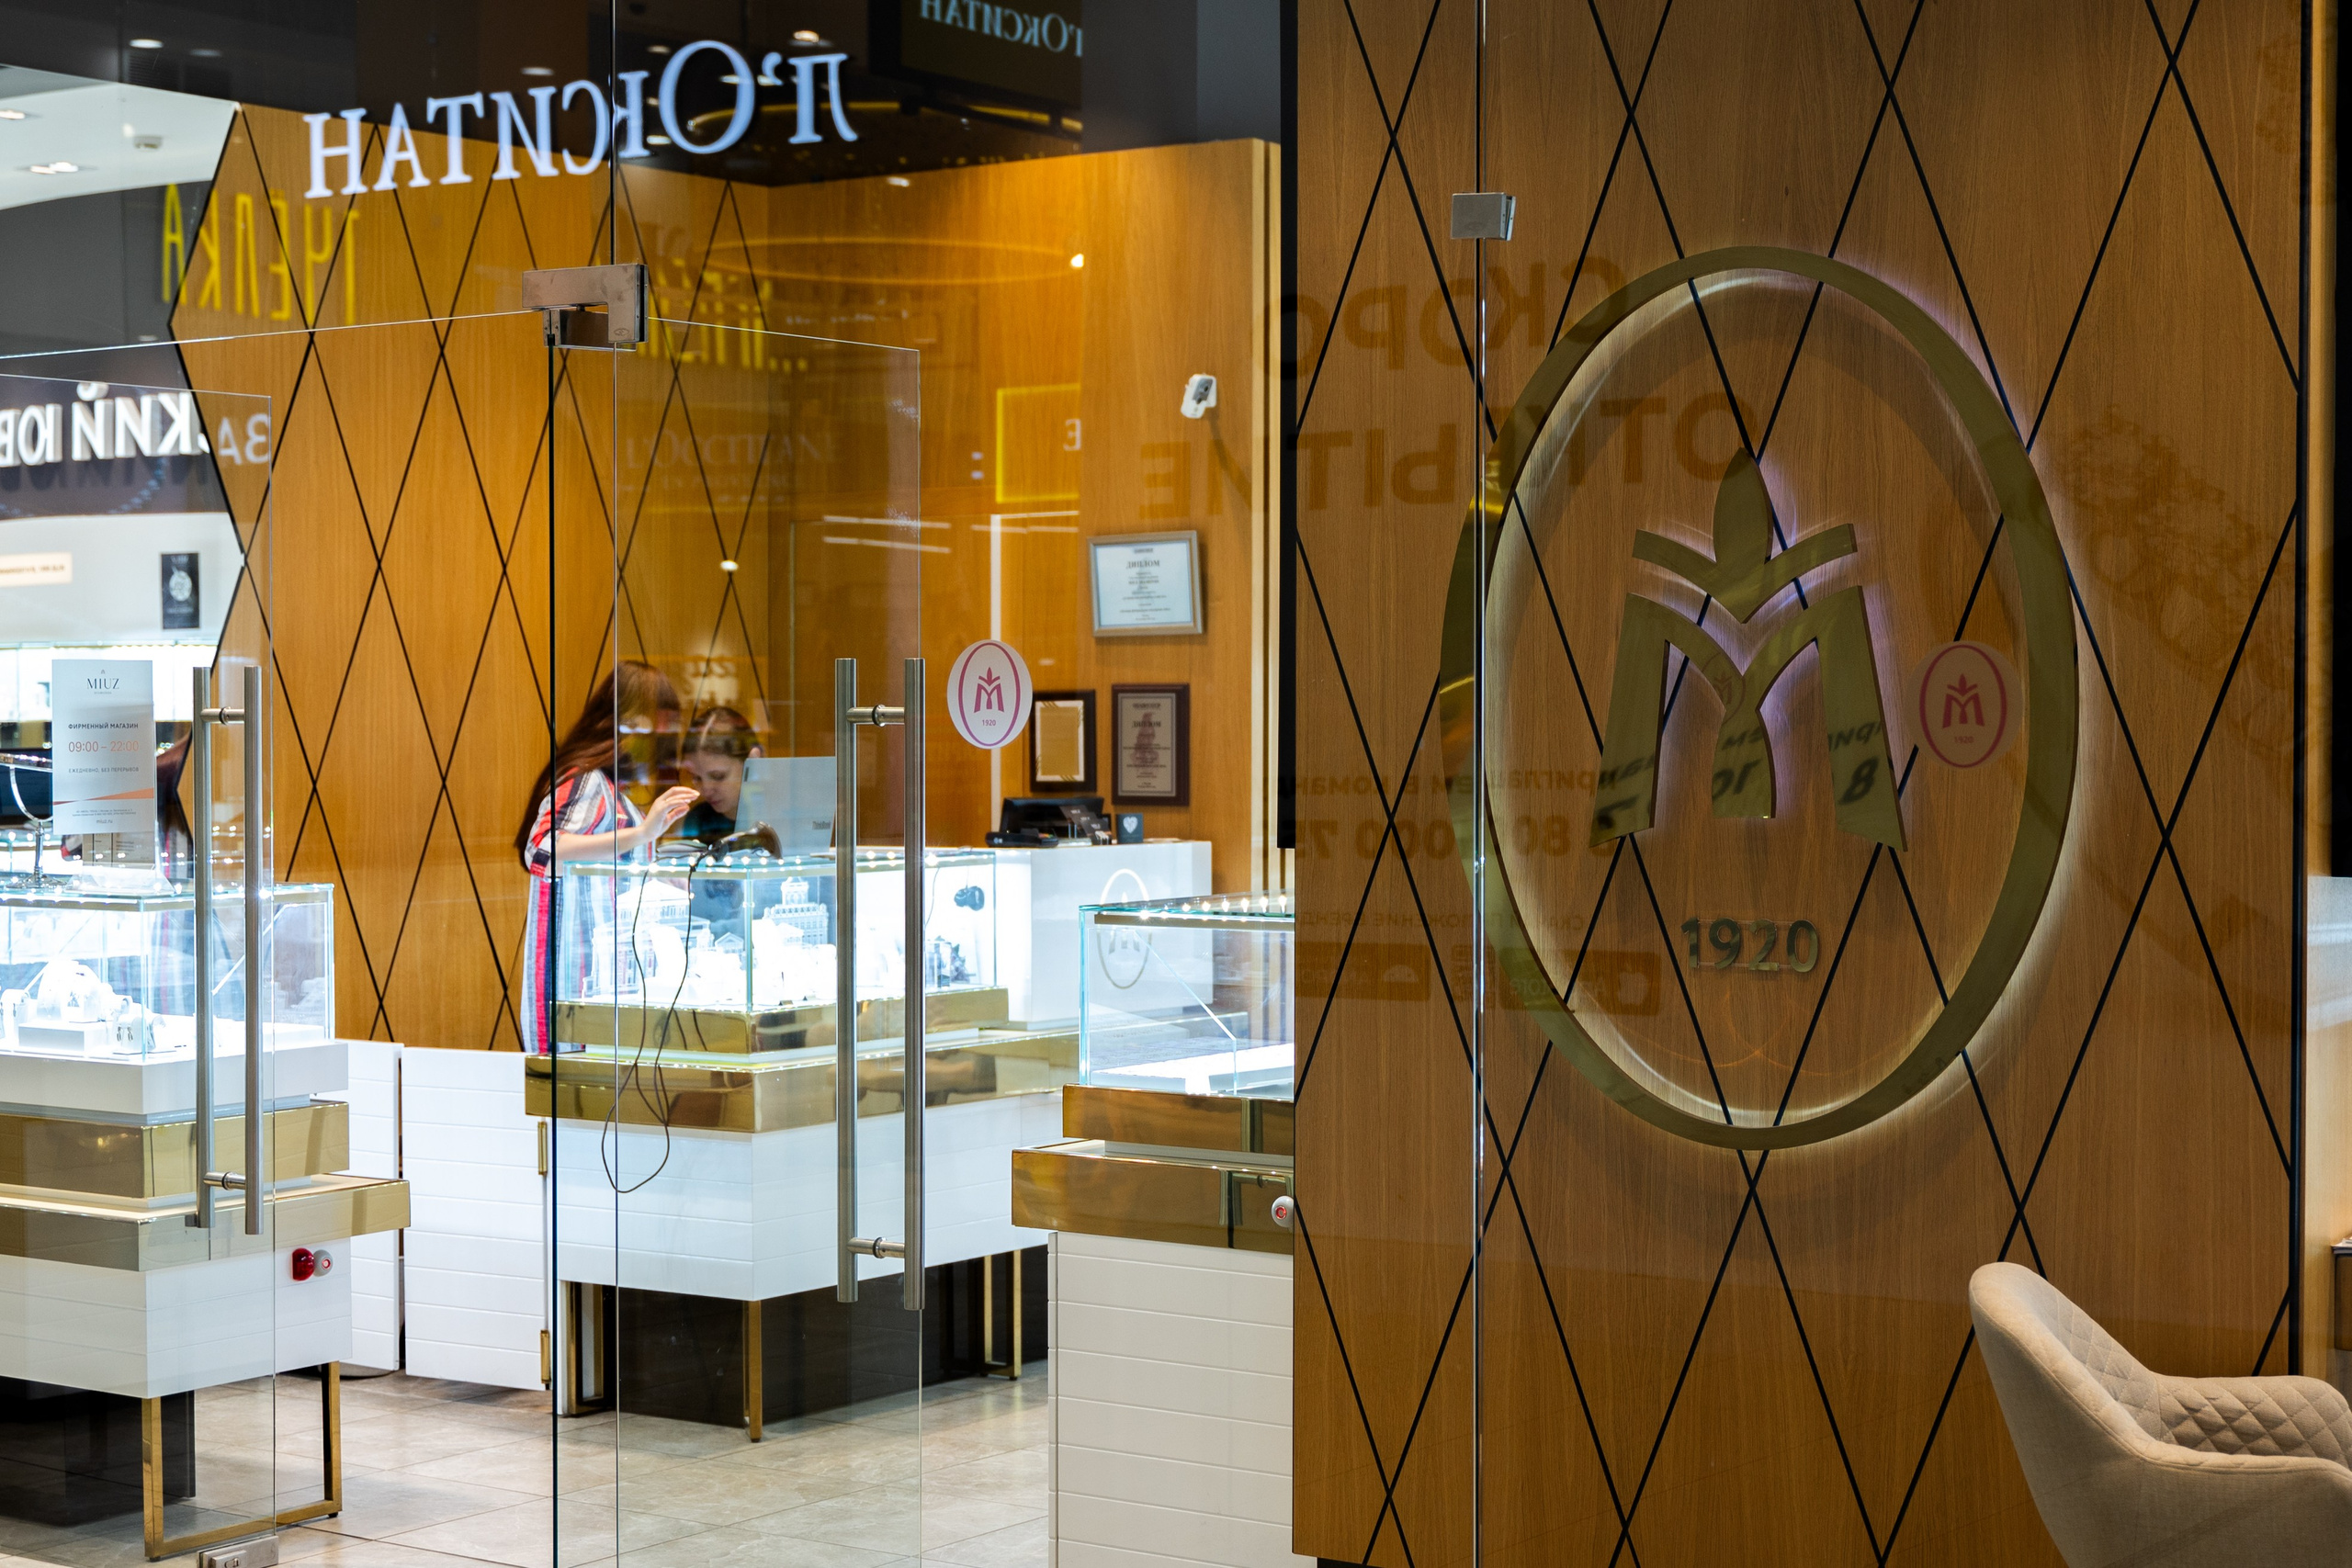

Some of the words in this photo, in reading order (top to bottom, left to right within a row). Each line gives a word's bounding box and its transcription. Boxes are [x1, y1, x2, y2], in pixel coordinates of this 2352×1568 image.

[86, 678, 120, 690] MIUZ
[68, 722, 108, 730] ФИРМЕННЫЙ
[981, 718, 997, 727] 1920
[68, 741, 99, 752] 09:00
[110, 740, 140, 751] 22:00
[1680, 916, 1819, 974] 1920
